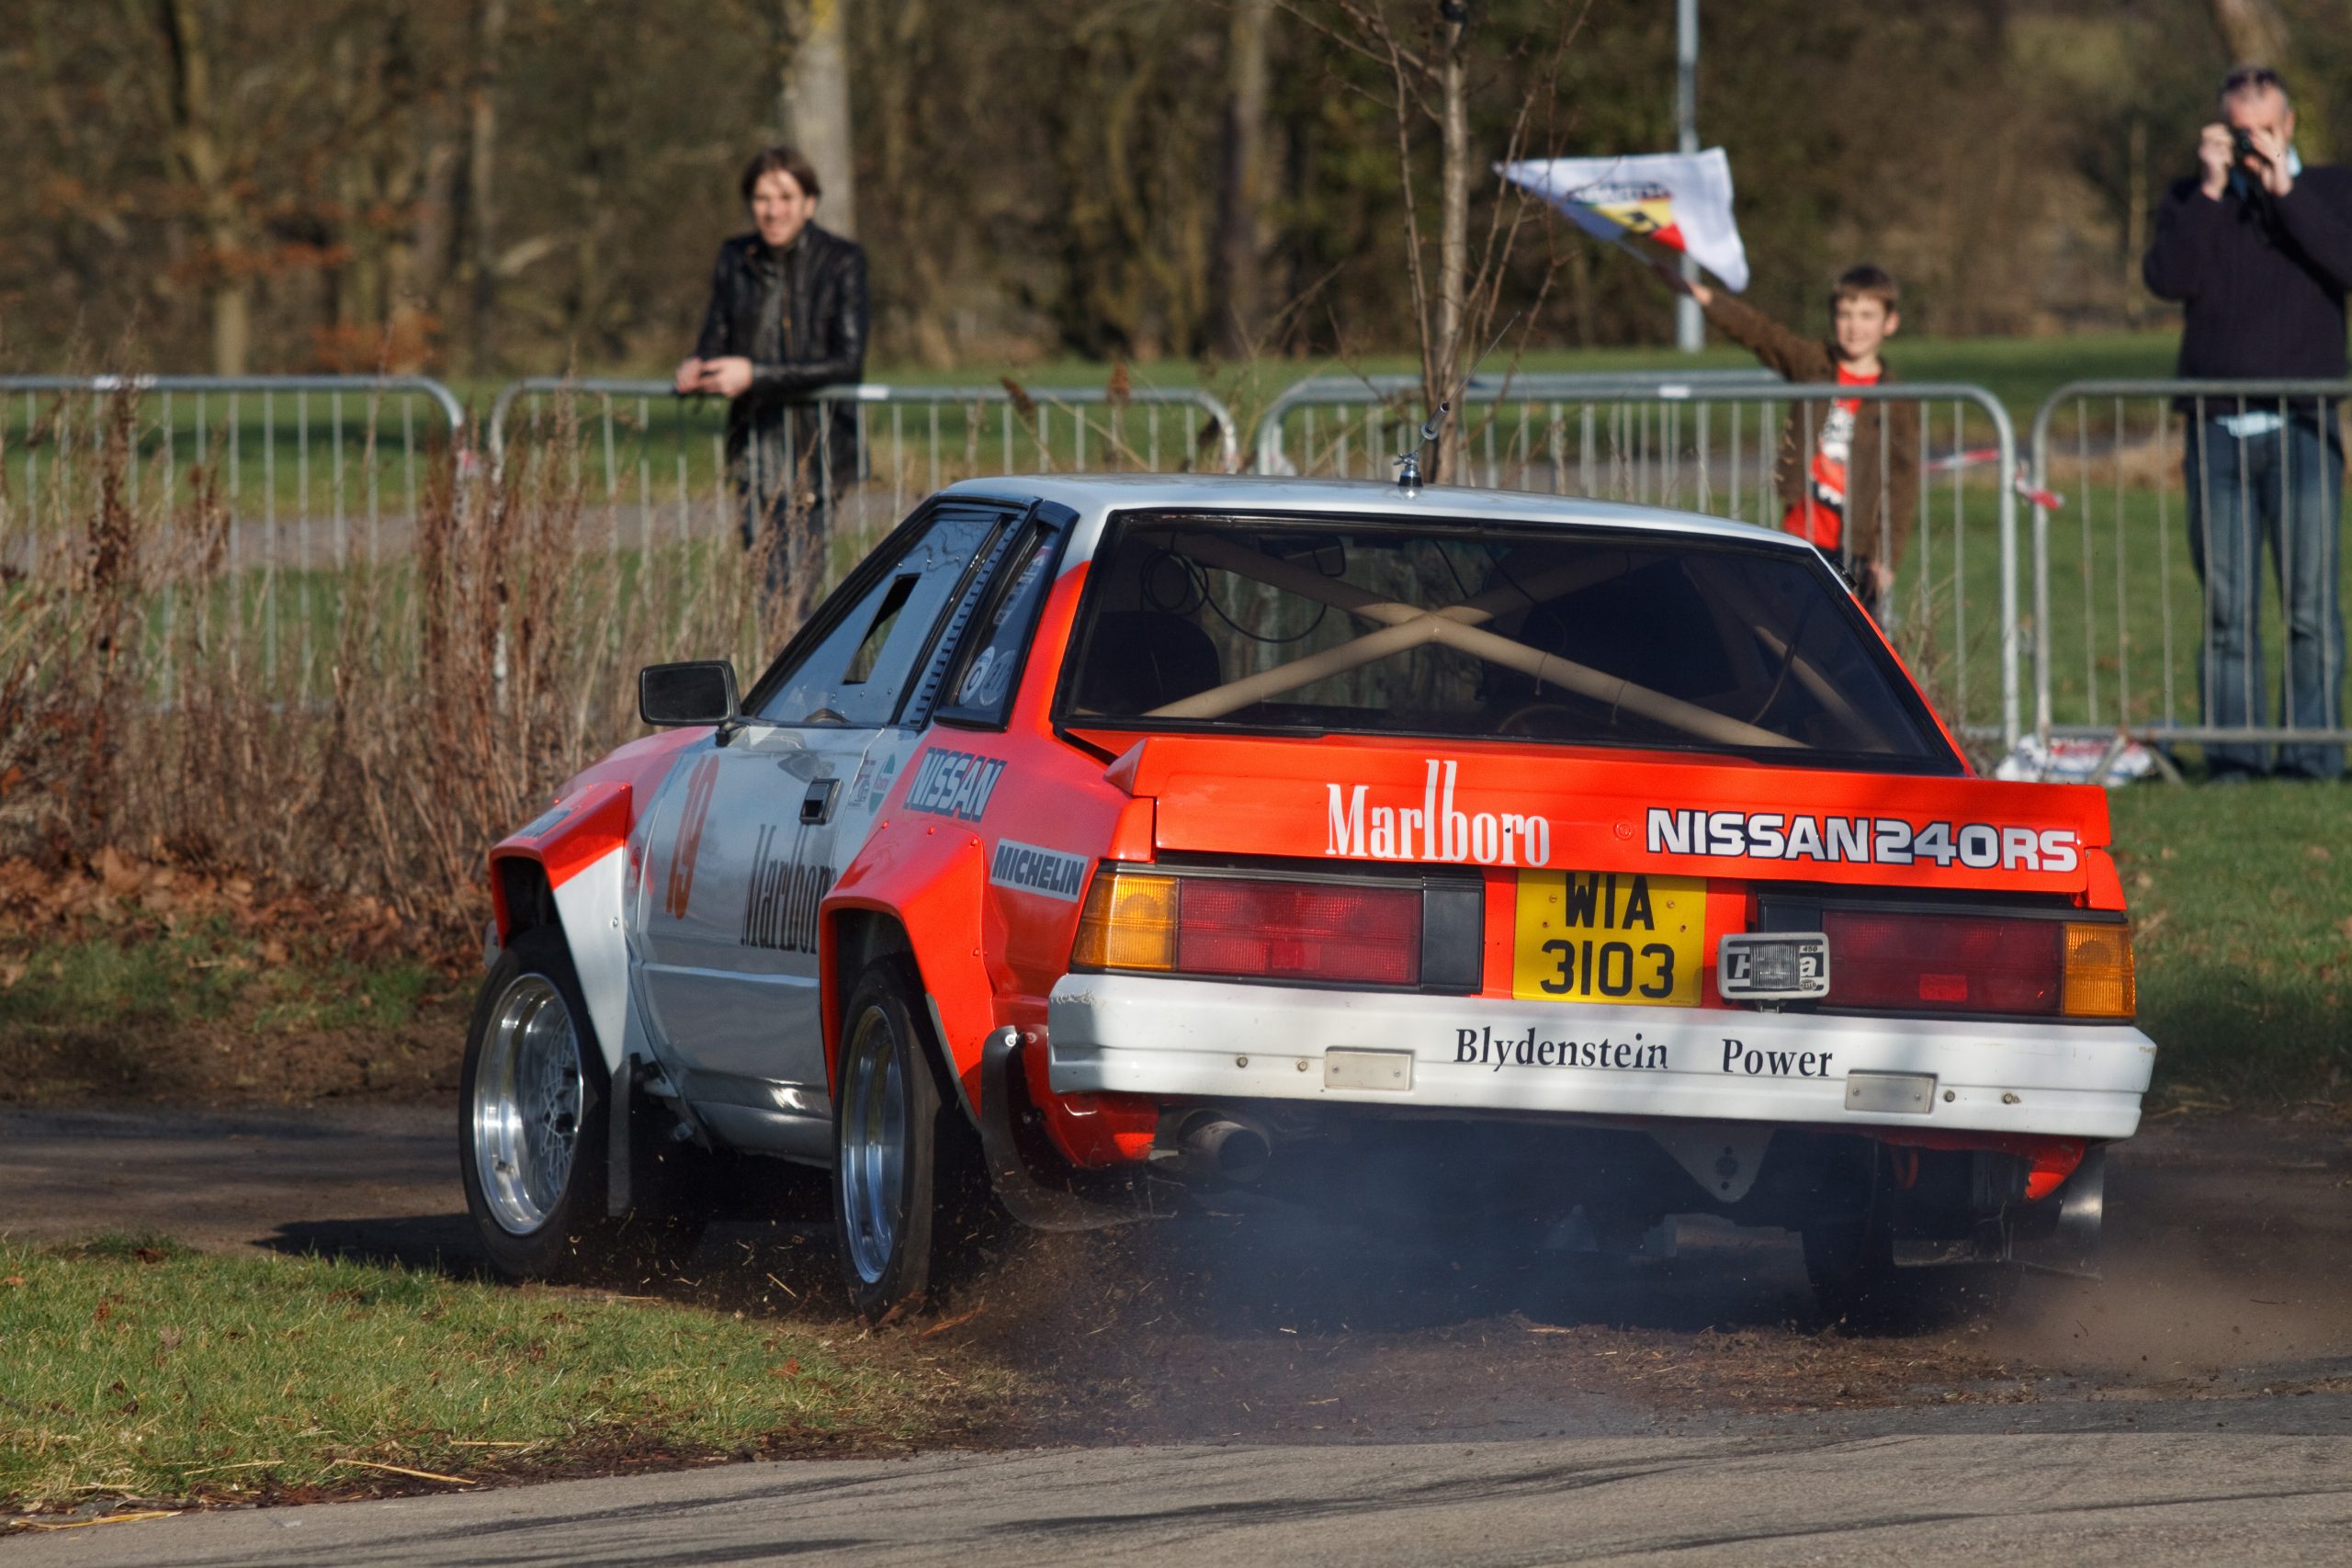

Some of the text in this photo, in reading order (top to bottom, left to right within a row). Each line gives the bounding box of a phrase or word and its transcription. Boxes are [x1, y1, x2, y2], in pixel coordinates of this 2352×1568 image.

[904, 747, 1007, 823] NISSAN
[1326, 759, 1550, 867] Marlboro
[741, 824, 837, 954] Marlbor
[991, 845, 1085, 896] MICHELIN
[1566, 873, 1655, 931] WIA
[1540, 939, 1675, 998] 3103
[1453, 1026, 1834, 1077] Blydenstein Power
